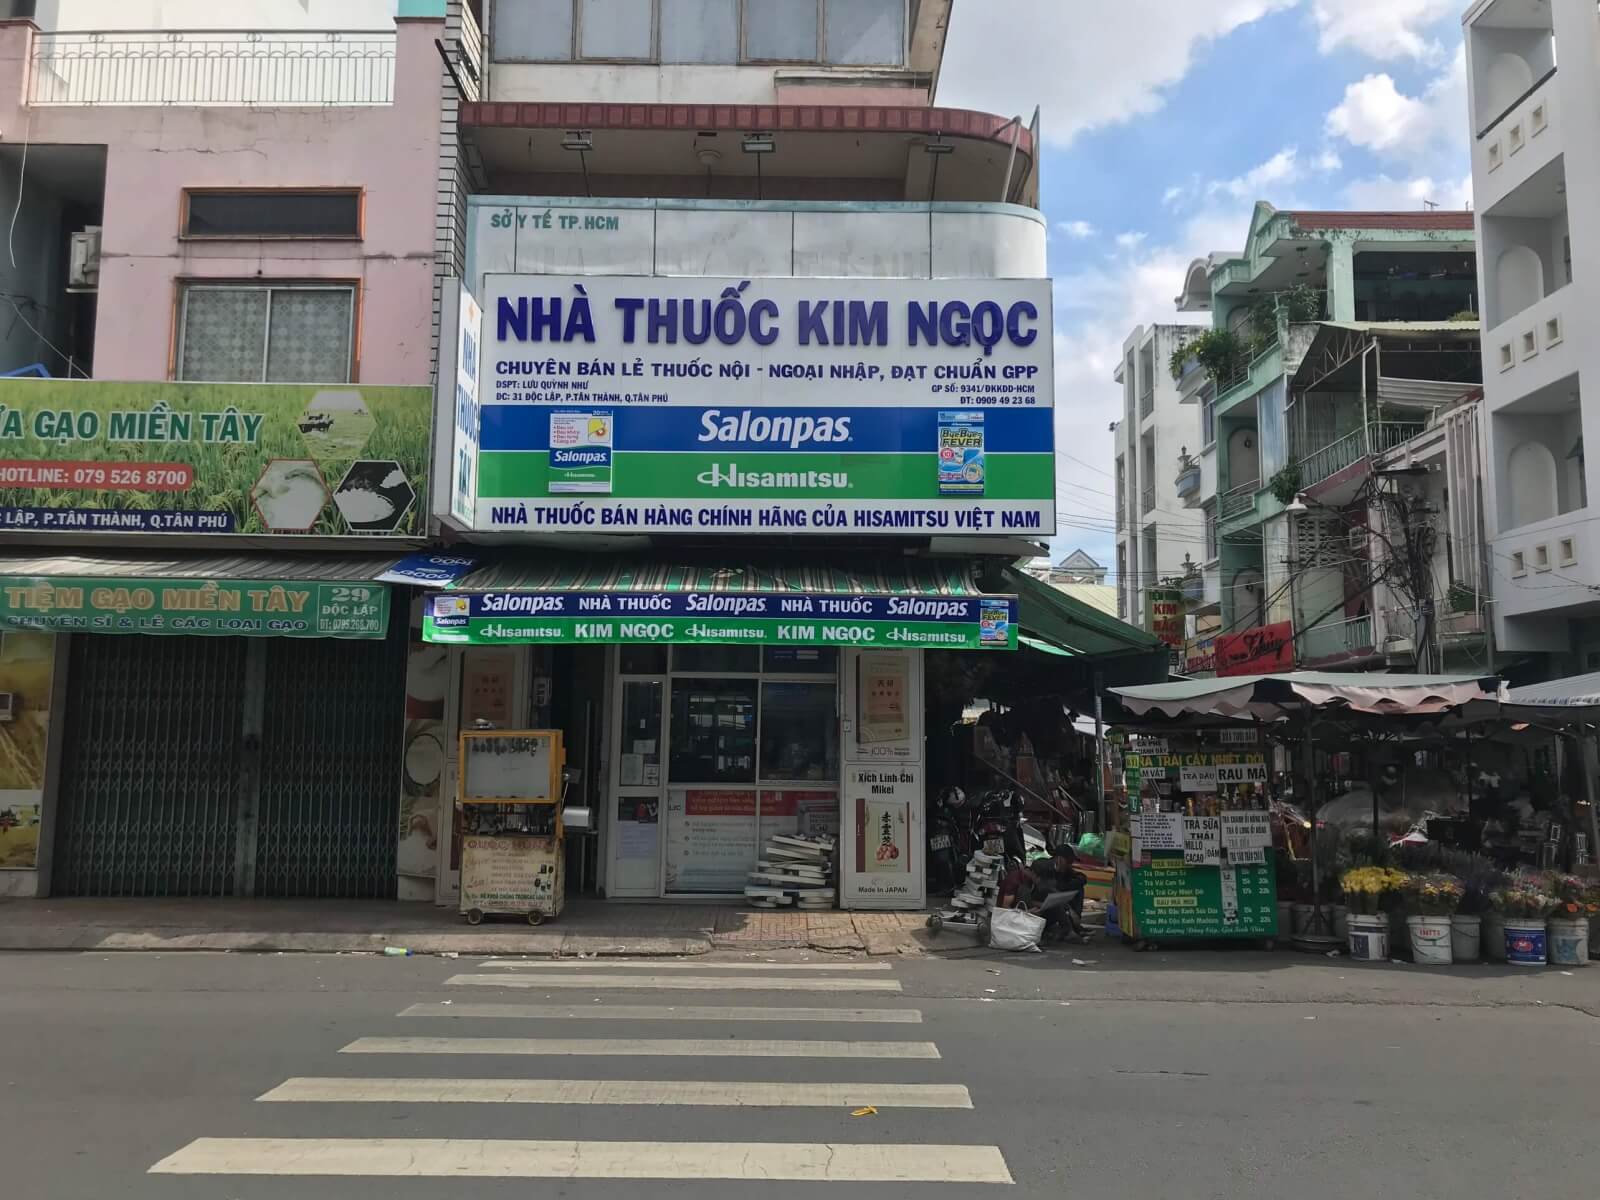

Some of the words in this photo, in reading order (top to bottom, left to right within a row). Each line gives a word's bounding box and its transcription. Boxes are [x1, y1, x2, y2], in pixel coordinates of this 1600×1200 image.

[491, 210, 512, 229] SỞ
[517, 214, 528, 229] Y
[532, 209, 552, 230] TẾ
[558, 215, 619, 231] TP.HCM
[497, 284, 596, 342] NHÀ
[614, 281, 779, 346] THUỐC
[798, 300, 888, 346] KIM
[908, 300, 1038, 356] NGỌC
[496, 359, 571, 377] CHUYÊN
[577, 358, 615, 377] BÁN
[622, 357, 644, 377] LẺ
[651, 357, 713, 378] THUỐC
[719, 360, 750, 379] NỘI
[769, 363, 823, 381] NGOẠI
[830, 361, 884, 382] NHẬP,
[891, 364, 927, 381] ĐẠT
[934, 358, 996, 380] CHUẨN
[1002, 365, 1038, 380] GPP
[512, 392, 522, 401] 31
[931, 384, 943, 393] GP
[976, 396, 997, 405] 0909
[999, 396, 1010, 405] 49
[1012, 396, 1023, 405] 23
[1025, 396, 1035, 405] 68
[0, 404, 25, 440] A
[34, 410, 99, 446] GẠO
[109, 400, 192, 443] MIỀN
[200, 406, 264, 443] TÂY
[698, 409, 850, 449] Salonpas
[554, 450, 607, 464] Salonpas
[75, 469, 105, 484] 079
[111, 470, 140, 485] 526
[147, 470, 187, 486] 8700
[697, 463, 847, 489] Hisamitsu
[6, 509, 39, 527] LẬP,
[44, 510, 87, 526] P.TÂN
[92, 510, 146, 529] THÀNH,
[151, 512, 193, 529] Q.TÂN
[198, 513, 228, 529] PHÚ
[491, 503, 527, 525] NHÀ
[534, 501, 595, 526] THUỐC
[601, 505, 638, 526] BÁN
[645, 503, 692, 527] HÀNG
[698, 505, 752, 527] CHÍNH
[758, 506, 806, 527] HÃNG
[812, 504, 848, 528] CỦA
[854, 510, 948, 528] HISAMITSU
[955, 506, 995, 530] VIỆT
[1001, 511, 1041, 528] NAM
[4, 582, 83, 613] TIỆM
[91, 587, 155, 613] GẠO
[162, 581, 241, 612] MIỀN
[247, 586, 309, 613] TÂY
[331, 587, 370, 602] 29
[481, 594, 564, 614] Salonpas
[579, 593, 611, 611] NHÀ
[617, 592, 672, 611] THUỐC
[686, 593, 766, 615] Salonpas
[781, 596, 813, 612] NHÀ
[819, 595, 872, 614] THUỐC
[886, 597, 968, 618] Salonpas
[480, 624, 562, 638] Hisamitsu
[575, 623, 612, 638] KIM
[620, 623, 674, 641] NGỌC
[685, 624, 764, 639] Hisamitsu
[778, 625, 815, 640] KIM
[822, 626, 875, 643] NGỌC
[886, 627, 966, 643] Hisamitsu
[900, 773, 914, 783] Chi
[1218, 768, 1243, 780] RAU
[1248, 765, 1267, 780] MÁ
[1184, 816, 1200, 830] TRÀ
[1203, 817, 1219, 830] SỮA
[1190, 831, 1214, 840] THÁI
